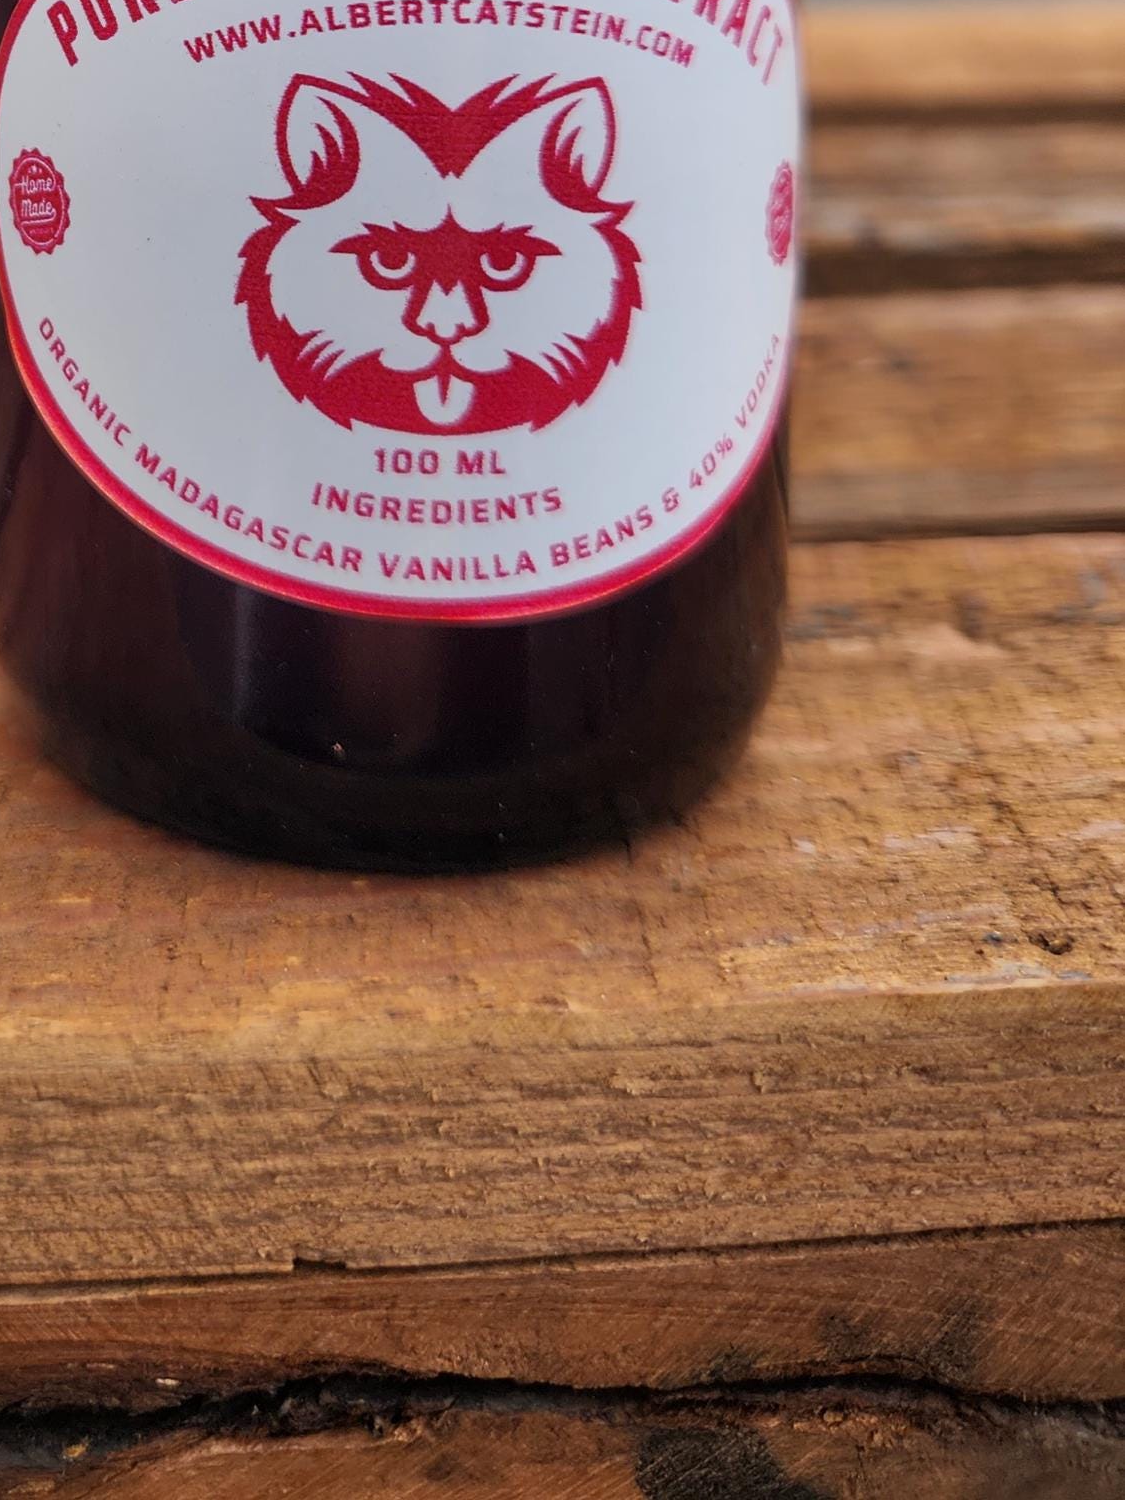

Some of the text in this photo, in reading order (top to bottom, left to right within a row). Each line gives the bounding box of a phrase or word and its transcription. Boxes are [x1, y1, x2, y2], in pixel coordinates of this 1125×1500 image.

[20, 175, 55, 194] Home
[21, 199, 53, 217] Made
[38, 317, 780, 582] ORGANIC MADAGASCAR VANILLA BEANS & 40% VODKA
[374, 447, 507, 477] 100 ML
[310, 483, 564, 527] INGREDIENTS
